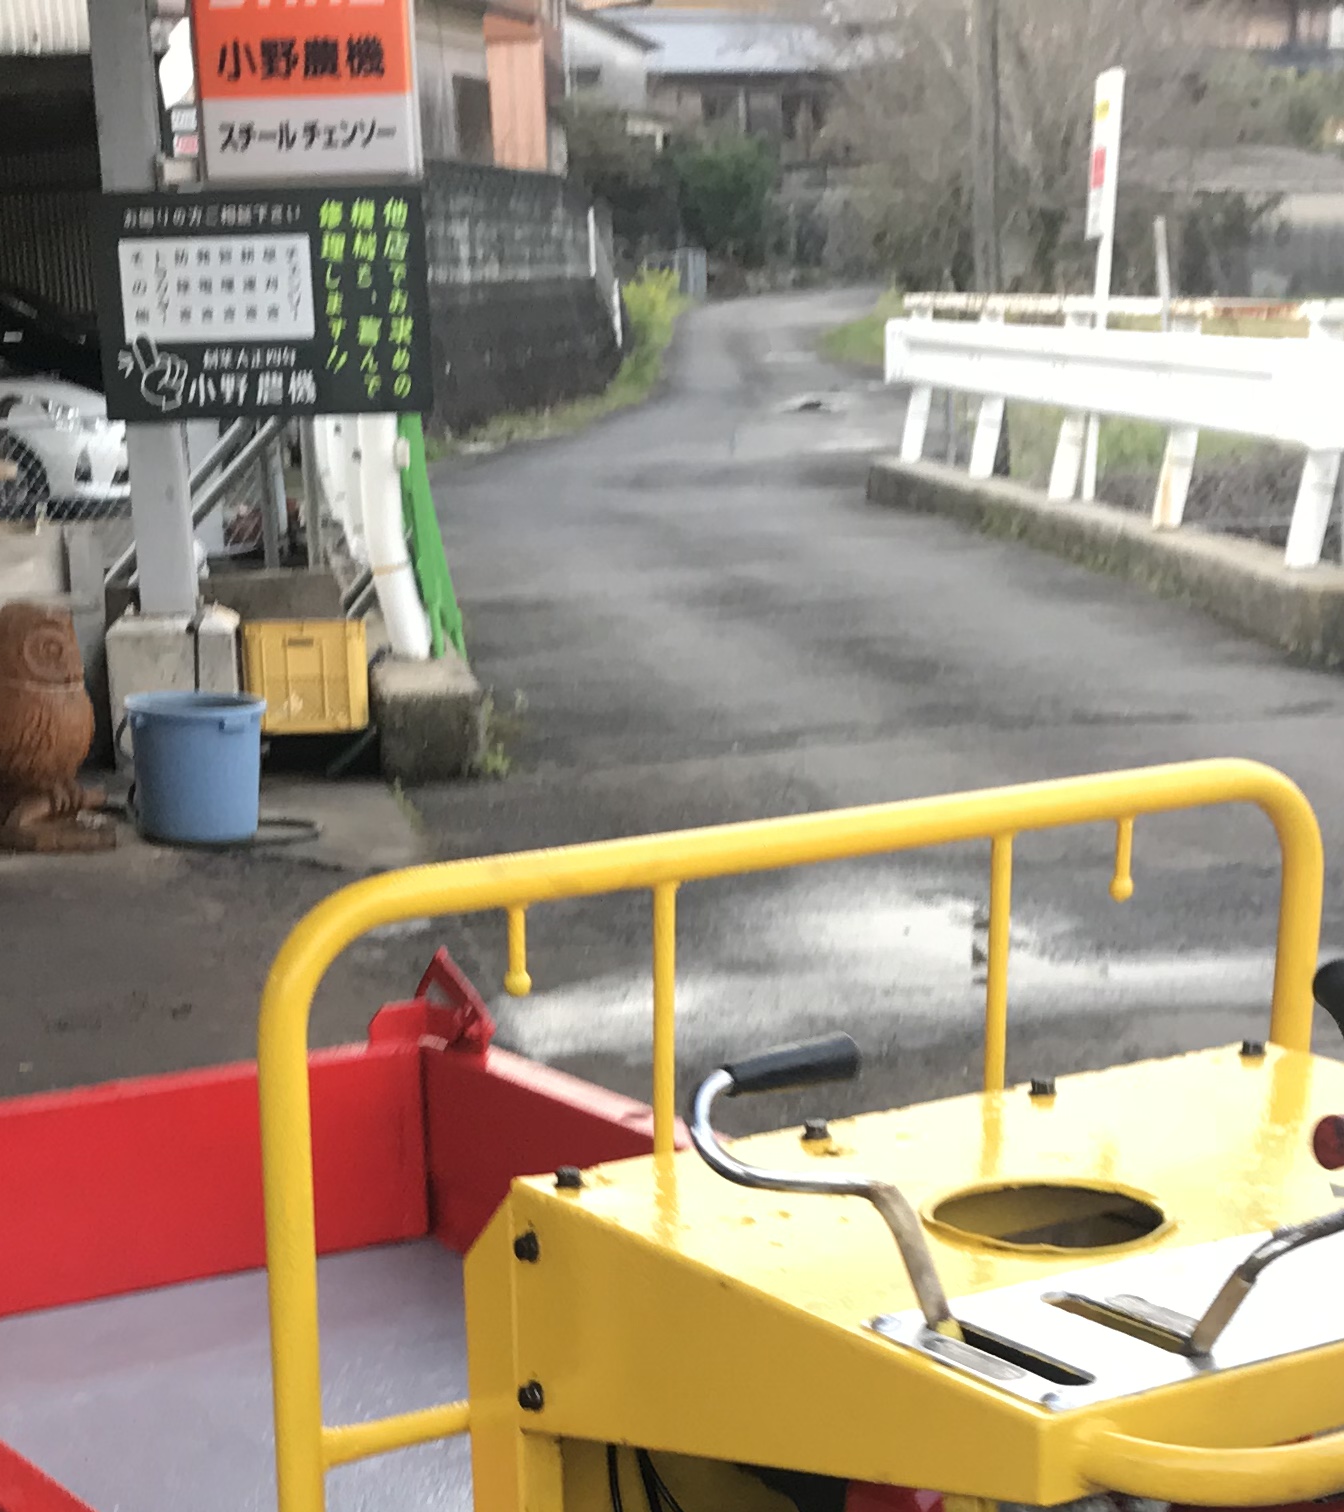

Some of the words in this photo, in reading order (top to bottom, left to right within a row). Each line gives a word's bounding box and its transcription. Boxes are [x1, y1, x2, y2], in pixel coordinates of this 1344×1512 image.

[217, 31, 385, 82] 小野農機
[187, 369, 317, 407] 小野農機
